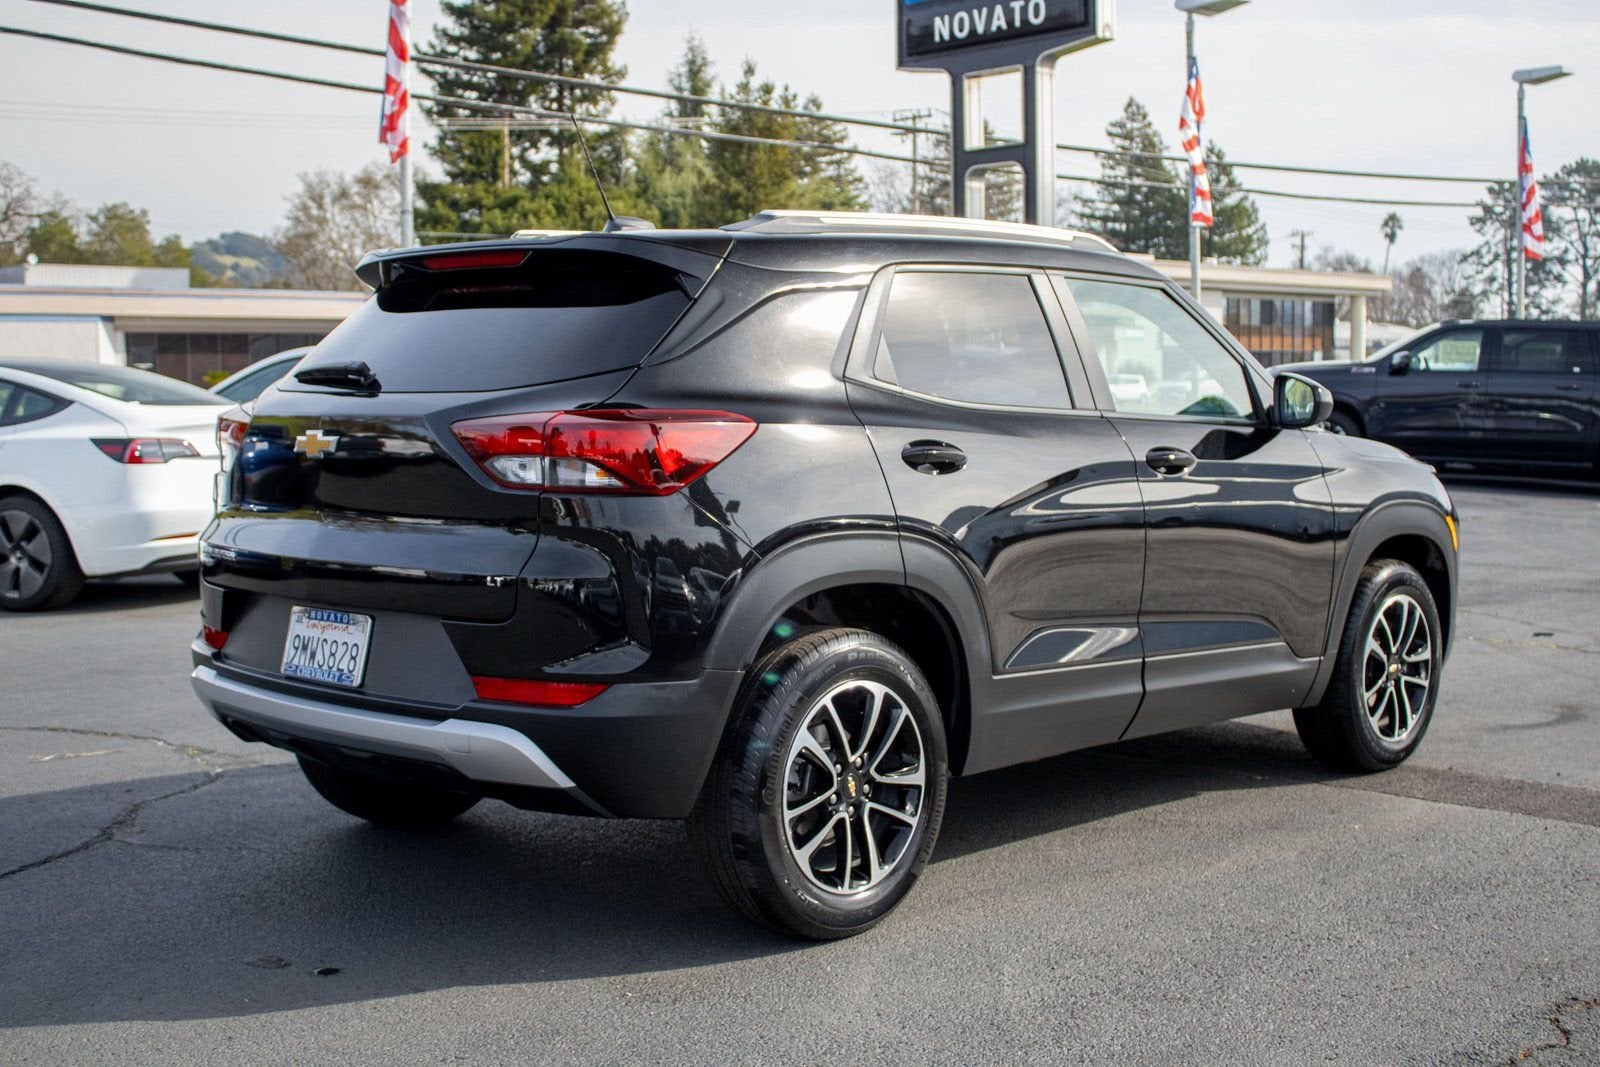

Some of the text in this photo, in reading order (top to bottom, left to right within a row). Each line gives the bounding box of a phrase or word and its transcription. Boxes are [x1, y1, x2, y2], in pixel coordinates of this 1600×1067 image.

[933, 0, 1046, 43] NOVATO
[486, 576, 504, 587] LT
[310, 610, 348, 624] NOVATO
[305, 619, 353, 635] California
[289, 634, 360, 674] 9MWS828
[297, 665, 340, 683] CHEVROLET
